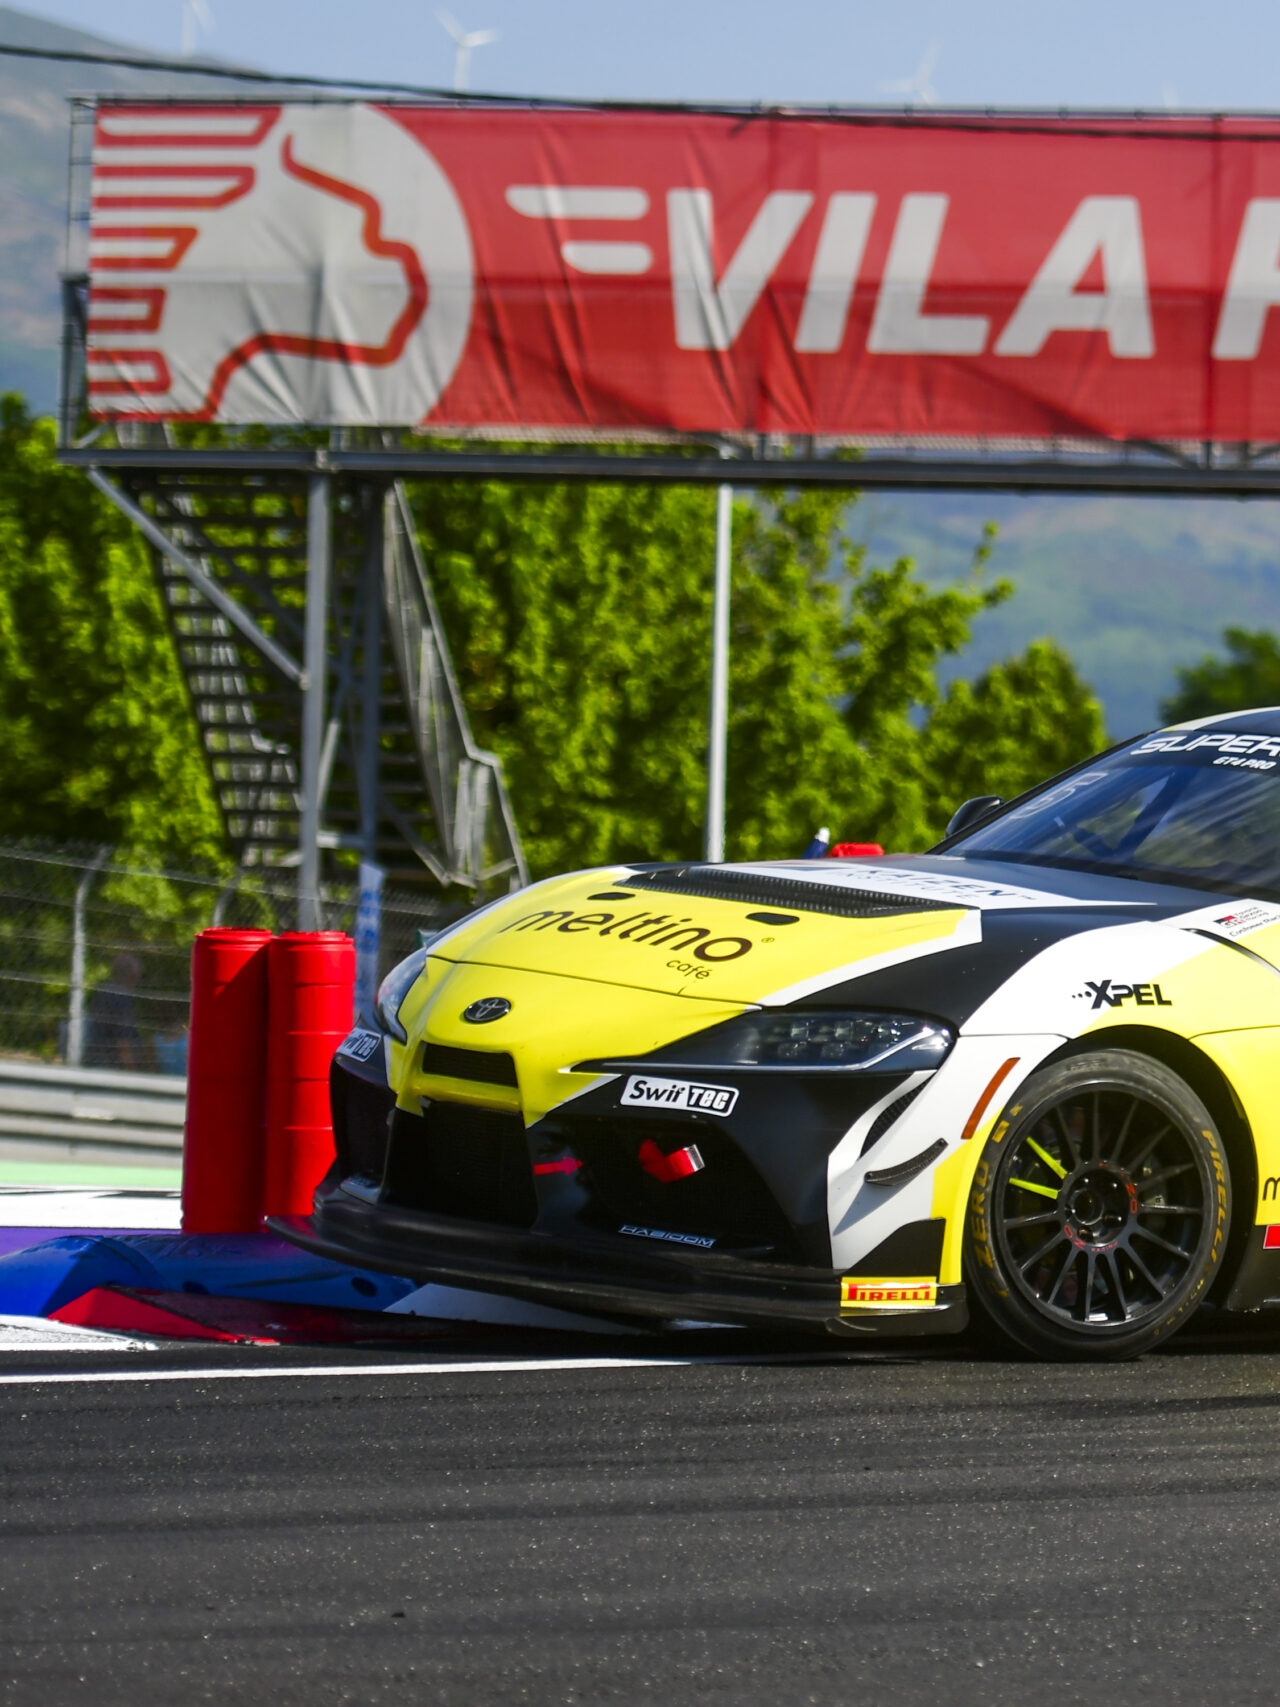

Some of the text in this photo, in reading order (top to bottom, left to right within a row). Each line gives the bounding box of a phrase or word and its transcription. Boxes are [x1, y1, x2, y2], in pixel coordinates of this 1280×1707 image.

[666, 189, 1155, 358] VILA
[1239, 758, 1277, 770] PRO
[666, 959, 710, 980] café
[1084, 979, 1173, 1010] XPEL
[847, 1283, 931, 1300] PIRELLI
